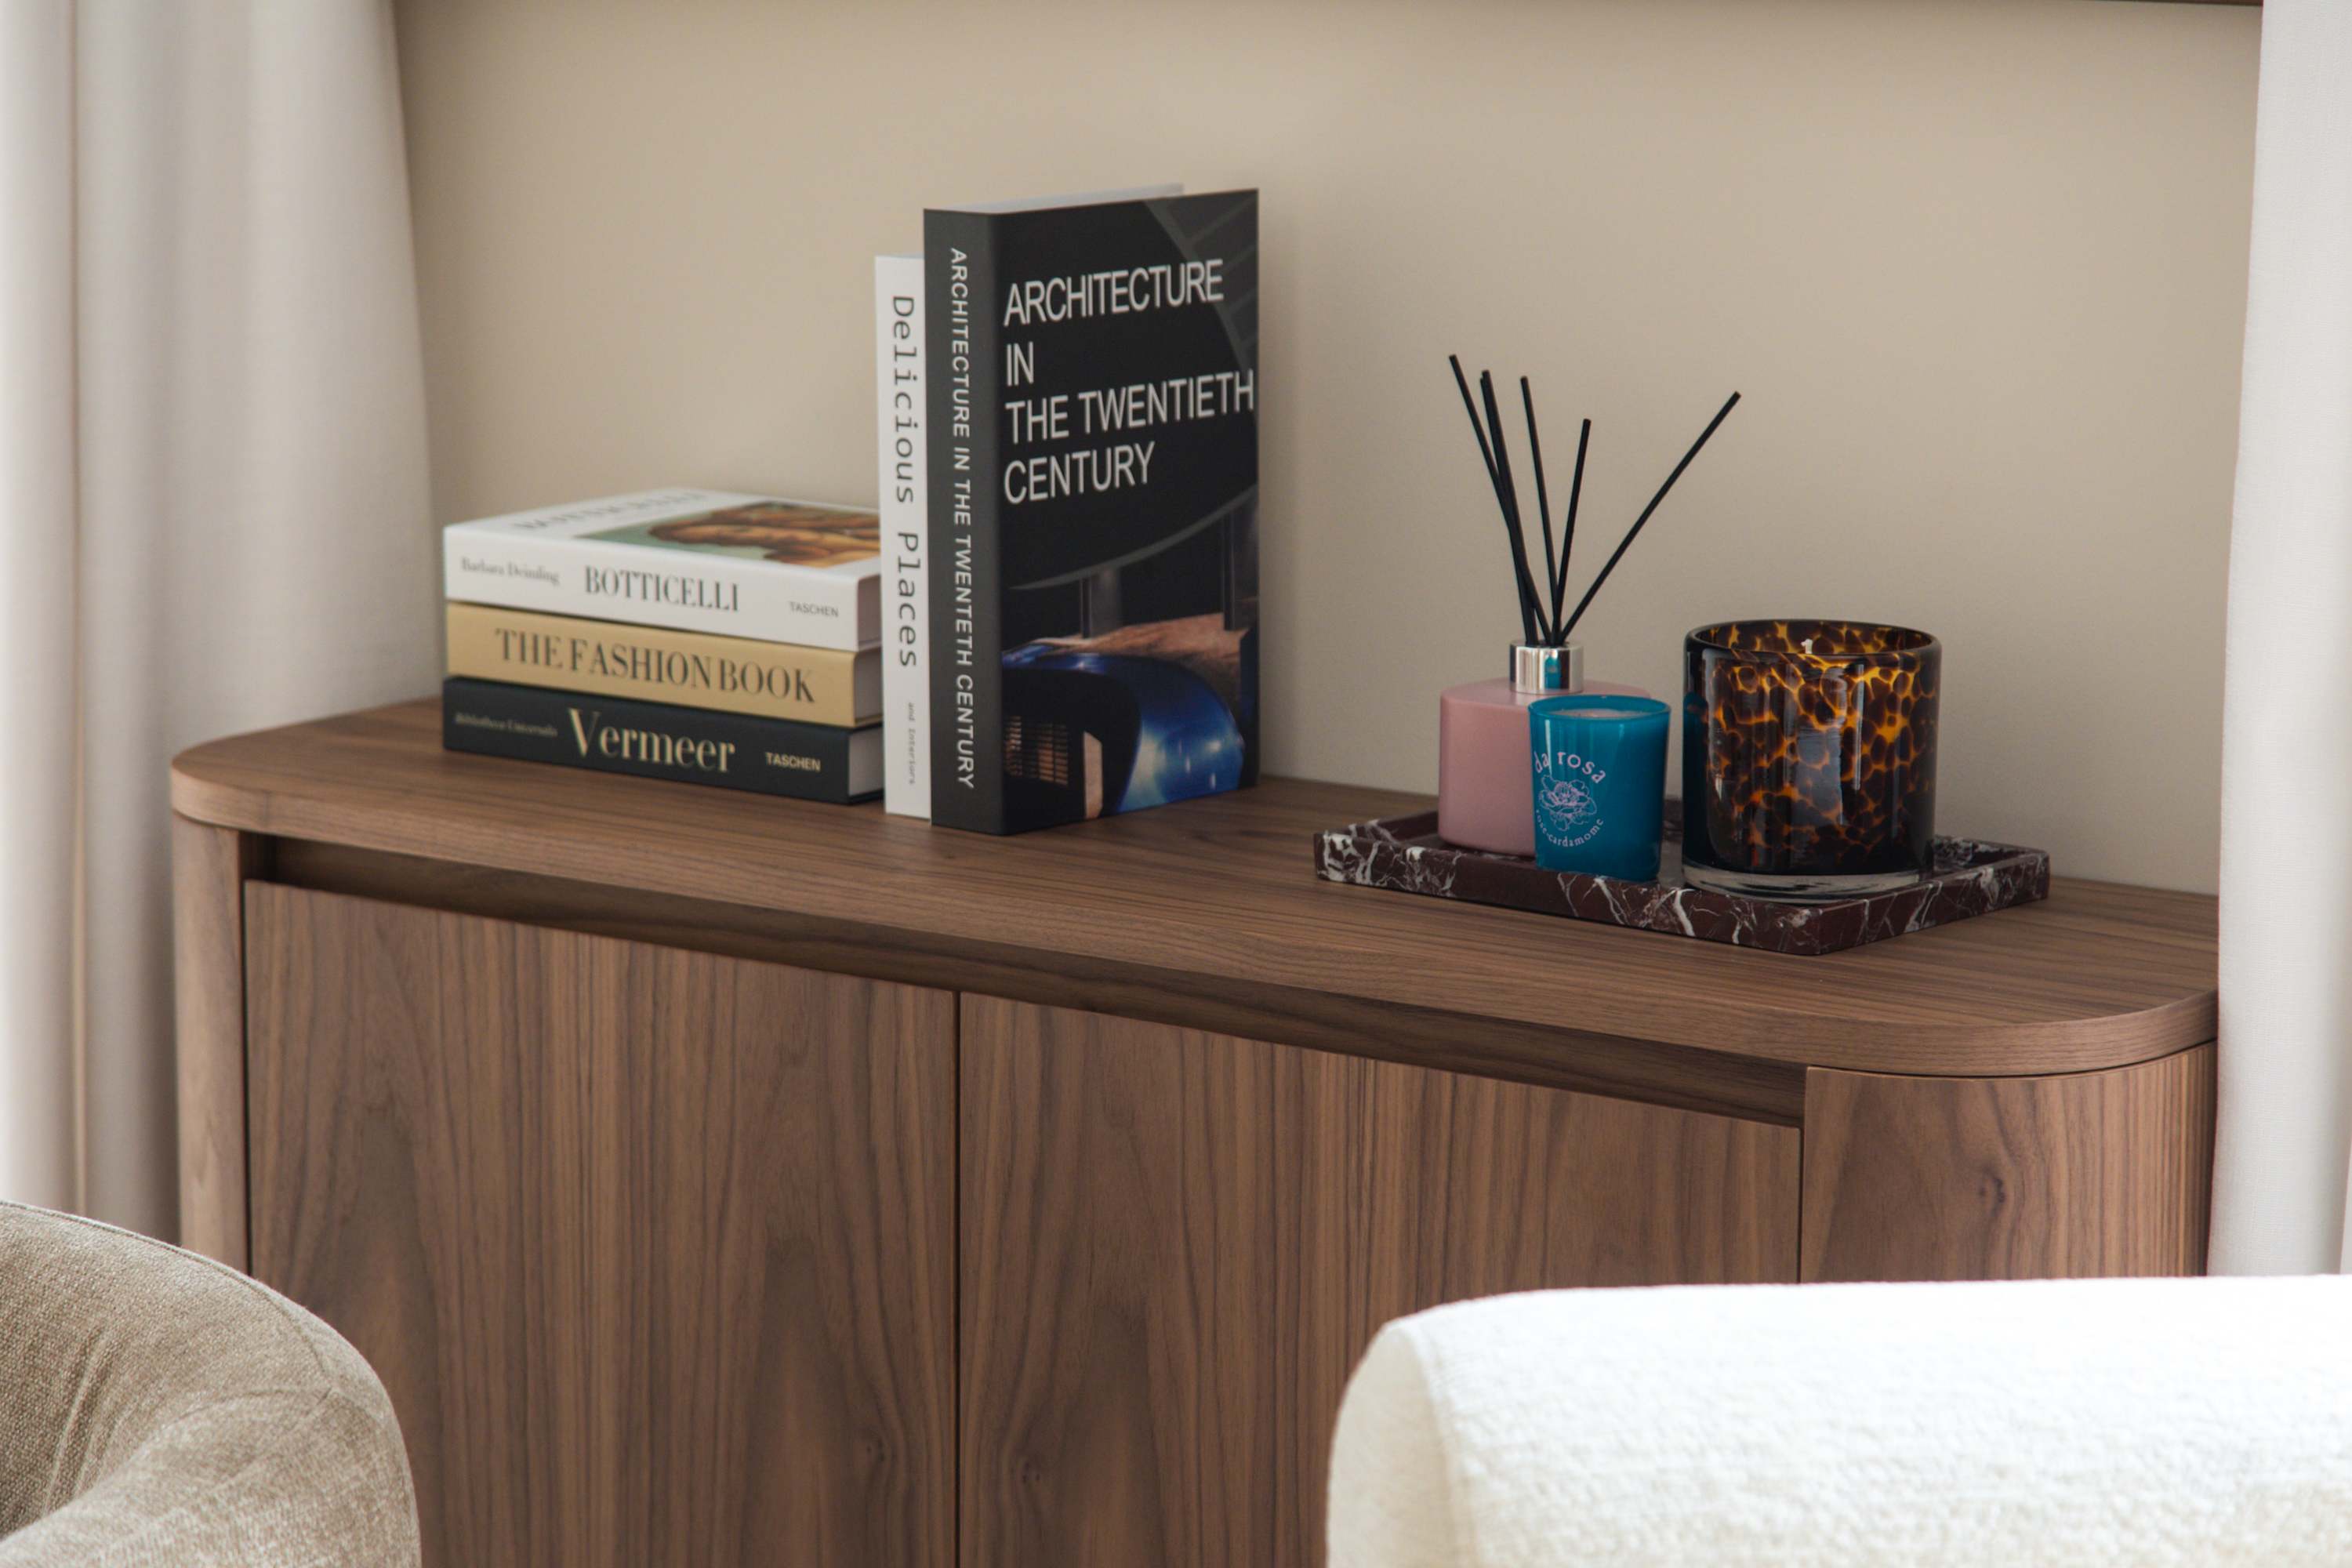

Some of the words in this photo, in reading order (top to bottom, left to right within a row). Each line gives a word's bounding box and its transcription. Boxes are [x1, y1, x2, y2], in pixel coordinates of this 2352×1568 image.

[1004, 258, 1225, 327] ARCHITECTURE
[950, 247, 970, 438] ARCHITECTURE
[1006, 341, 1034, 387] IN
[892, 296, 919, 504] Delicious
[1005, 394, 1069, 445] THE
[1078, 369, 1254, 434] TWENTIETH
[953, 447, 971, 470] IN
[1004, 441, 1156, 504] CENTURY
[953, 479, 971, 526] THE
[585, 564, 739, 613] BOTTICELLI
[789, 601, 839, 618] TASCHEN
[897, 531, 921, 667] Places
[954, 535, 973, 666] TWENTETH
[495, 628, 563, 670] THE
[570, 637, 711, 690] FASHION
[719, 656, 815, 702] BOOK
[567, 706, 735, 772] Vermeer
[765, 752, 822, 772] TASCHEN
[955, 674, 975, 789] CENTURY
[1534, 750, 1551, 774] da
[1557, 751, 1606, 784] rosa
